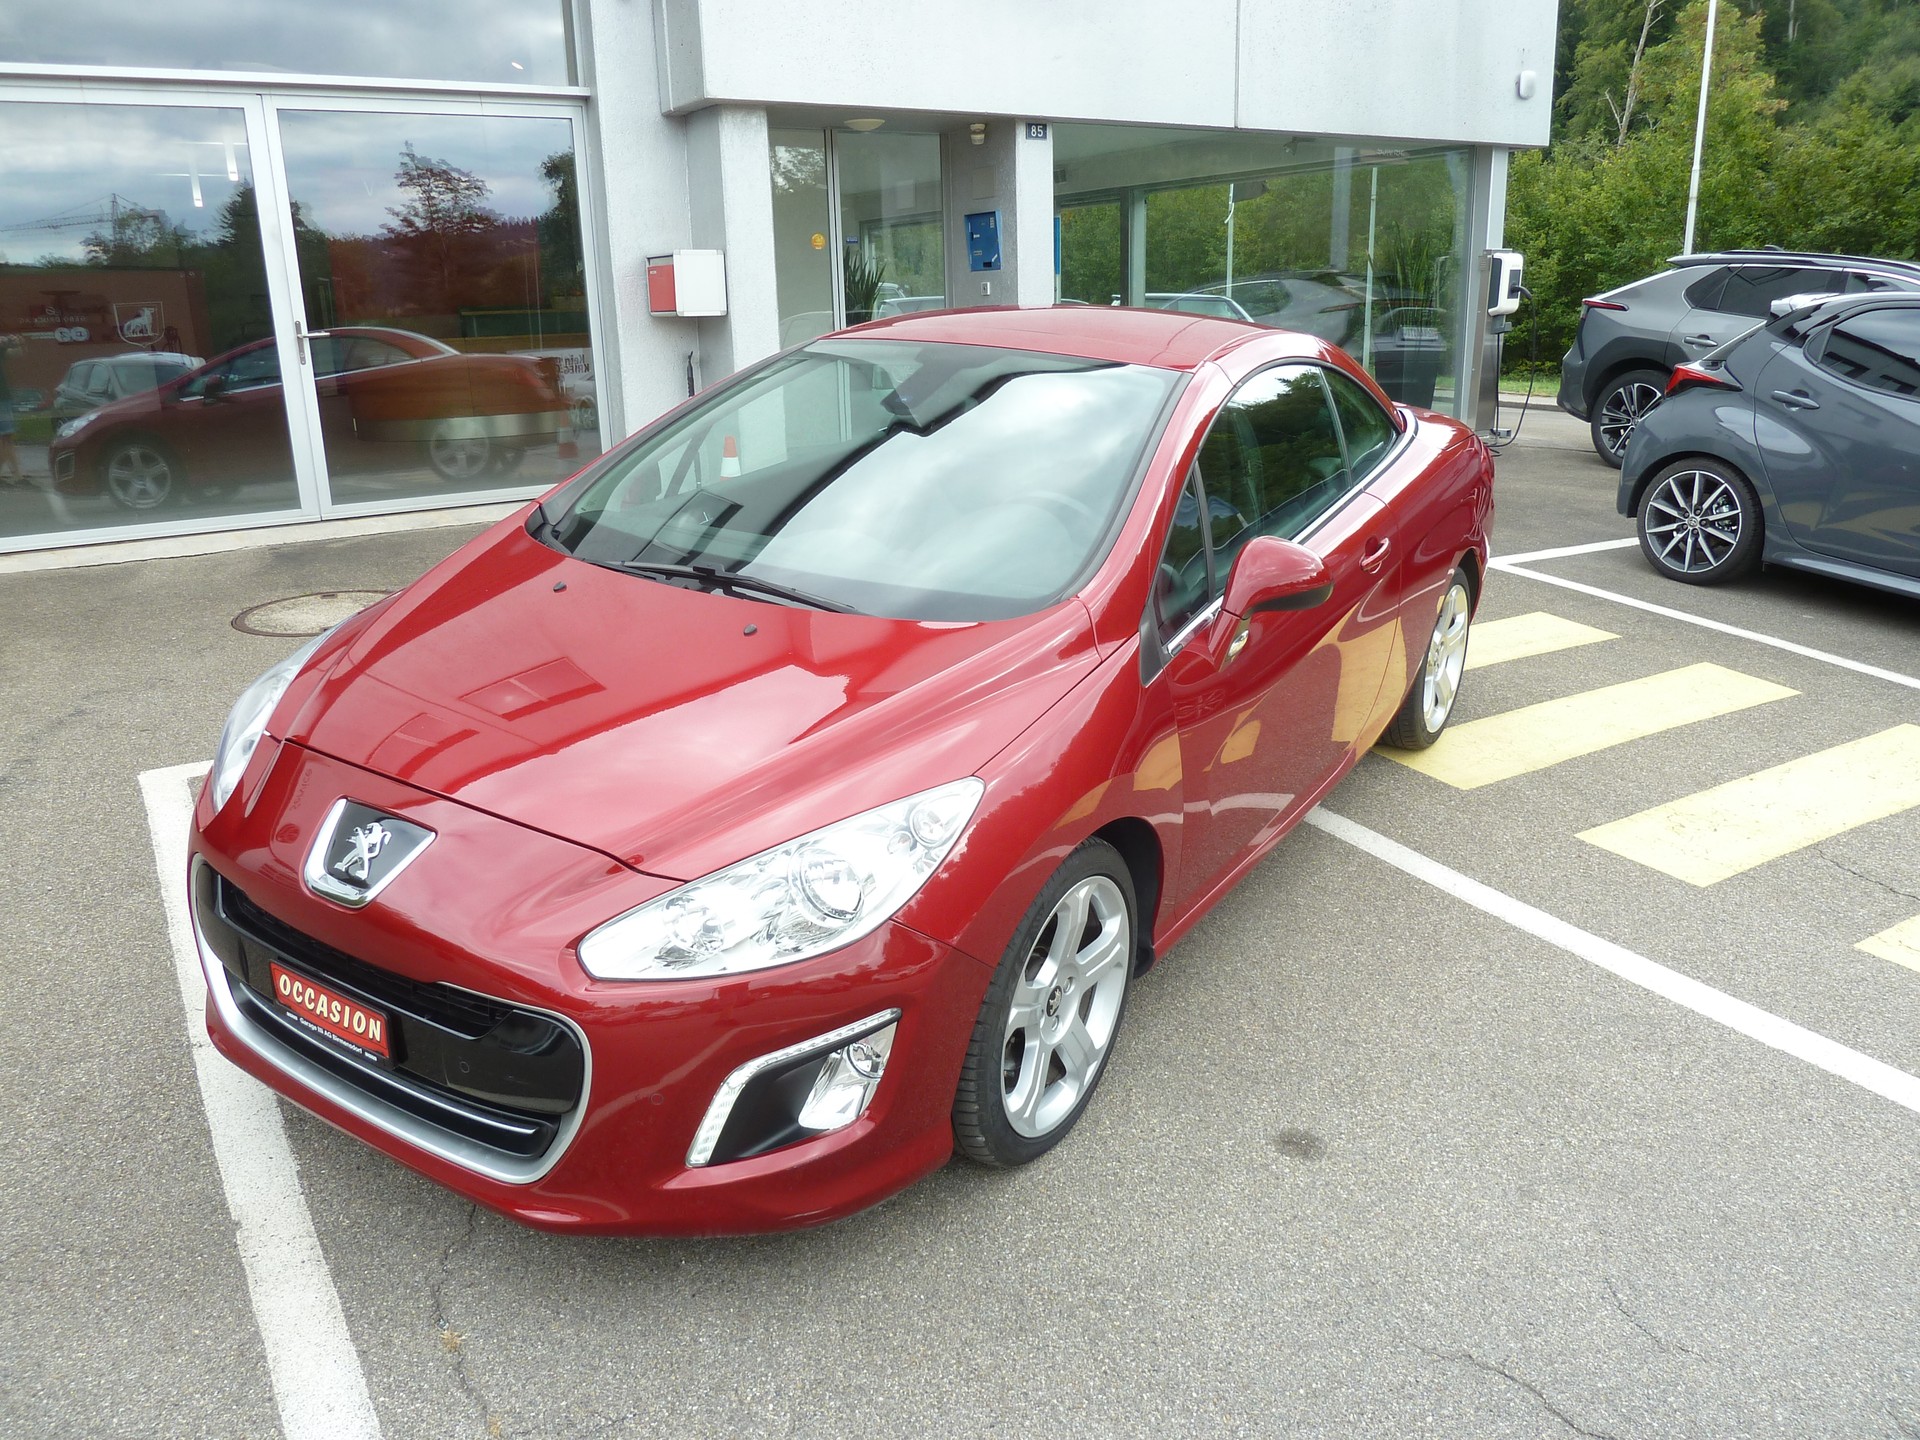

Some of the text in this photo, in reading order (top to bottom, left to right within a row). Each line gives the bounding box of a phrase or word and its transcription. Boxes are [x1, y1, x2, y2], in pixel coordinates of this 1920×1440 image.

[1031, 125, 1044, 137] 85
[279, 974, 381, 1042] OCCASION
[300, 1017, 317, 1031] Garage
